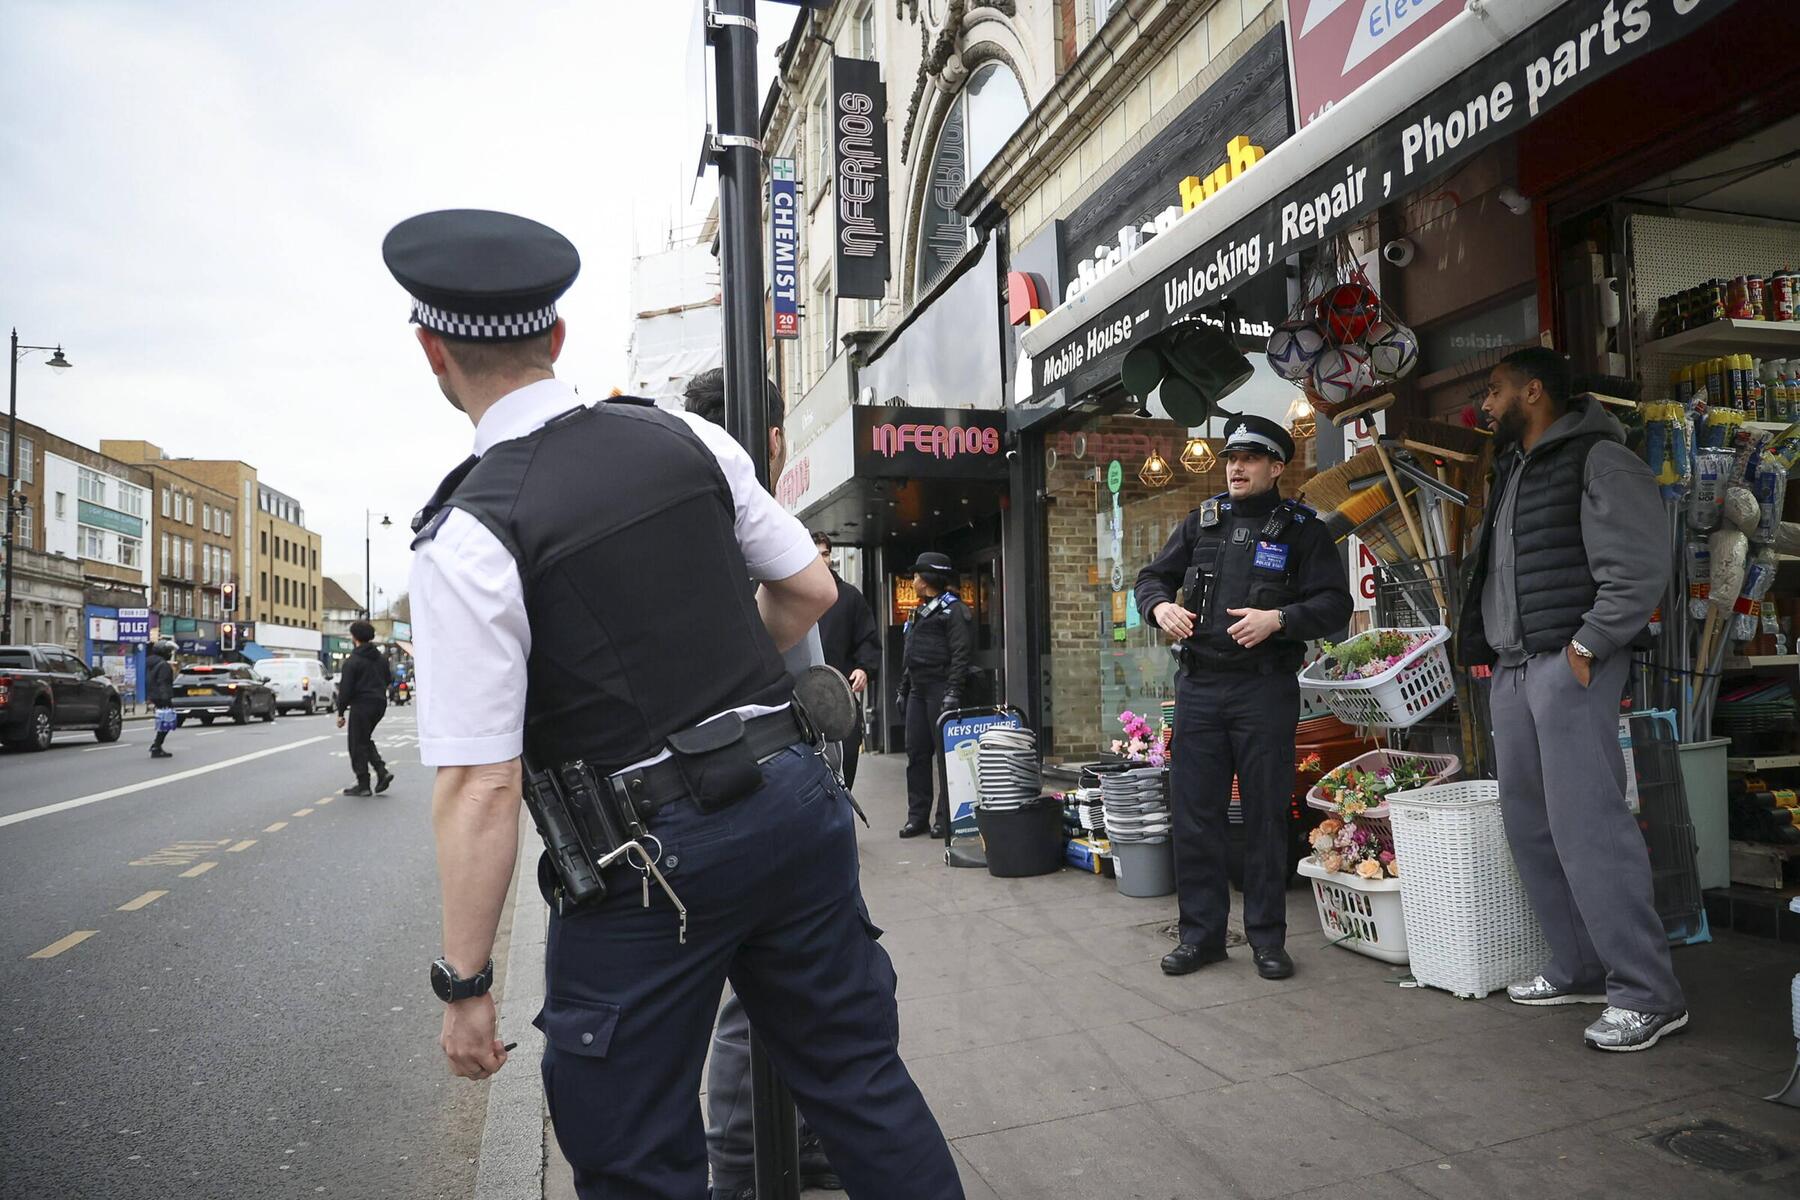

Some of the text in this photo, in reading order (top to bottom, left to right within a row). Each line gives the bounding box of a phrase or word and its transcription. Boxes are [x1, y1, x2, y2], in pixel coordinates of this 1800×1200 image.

[1369, 0, 1423, 37] Ele
[838, 92, 884, 258] INFERNOS
[1179, 135, 1265, 214] hub
[1043, 341, 1083, 386] Mobile
[1086, 314, 1132, 361] House
[1402, 81, 1513, 176] Phone
[1526, 0, 1651, 118] parts
[774, 192, 795, 302] CHEMIST
[779, 314, 794, 325] 20
[1239, 318, 1274, 337] hub
[873, 424, 1000, 460] INFERNOS
[119, 622, 148, 633] TO LET
[947, 724, 972, 737] KEYS
[973, 722, 992, 734] CUT
